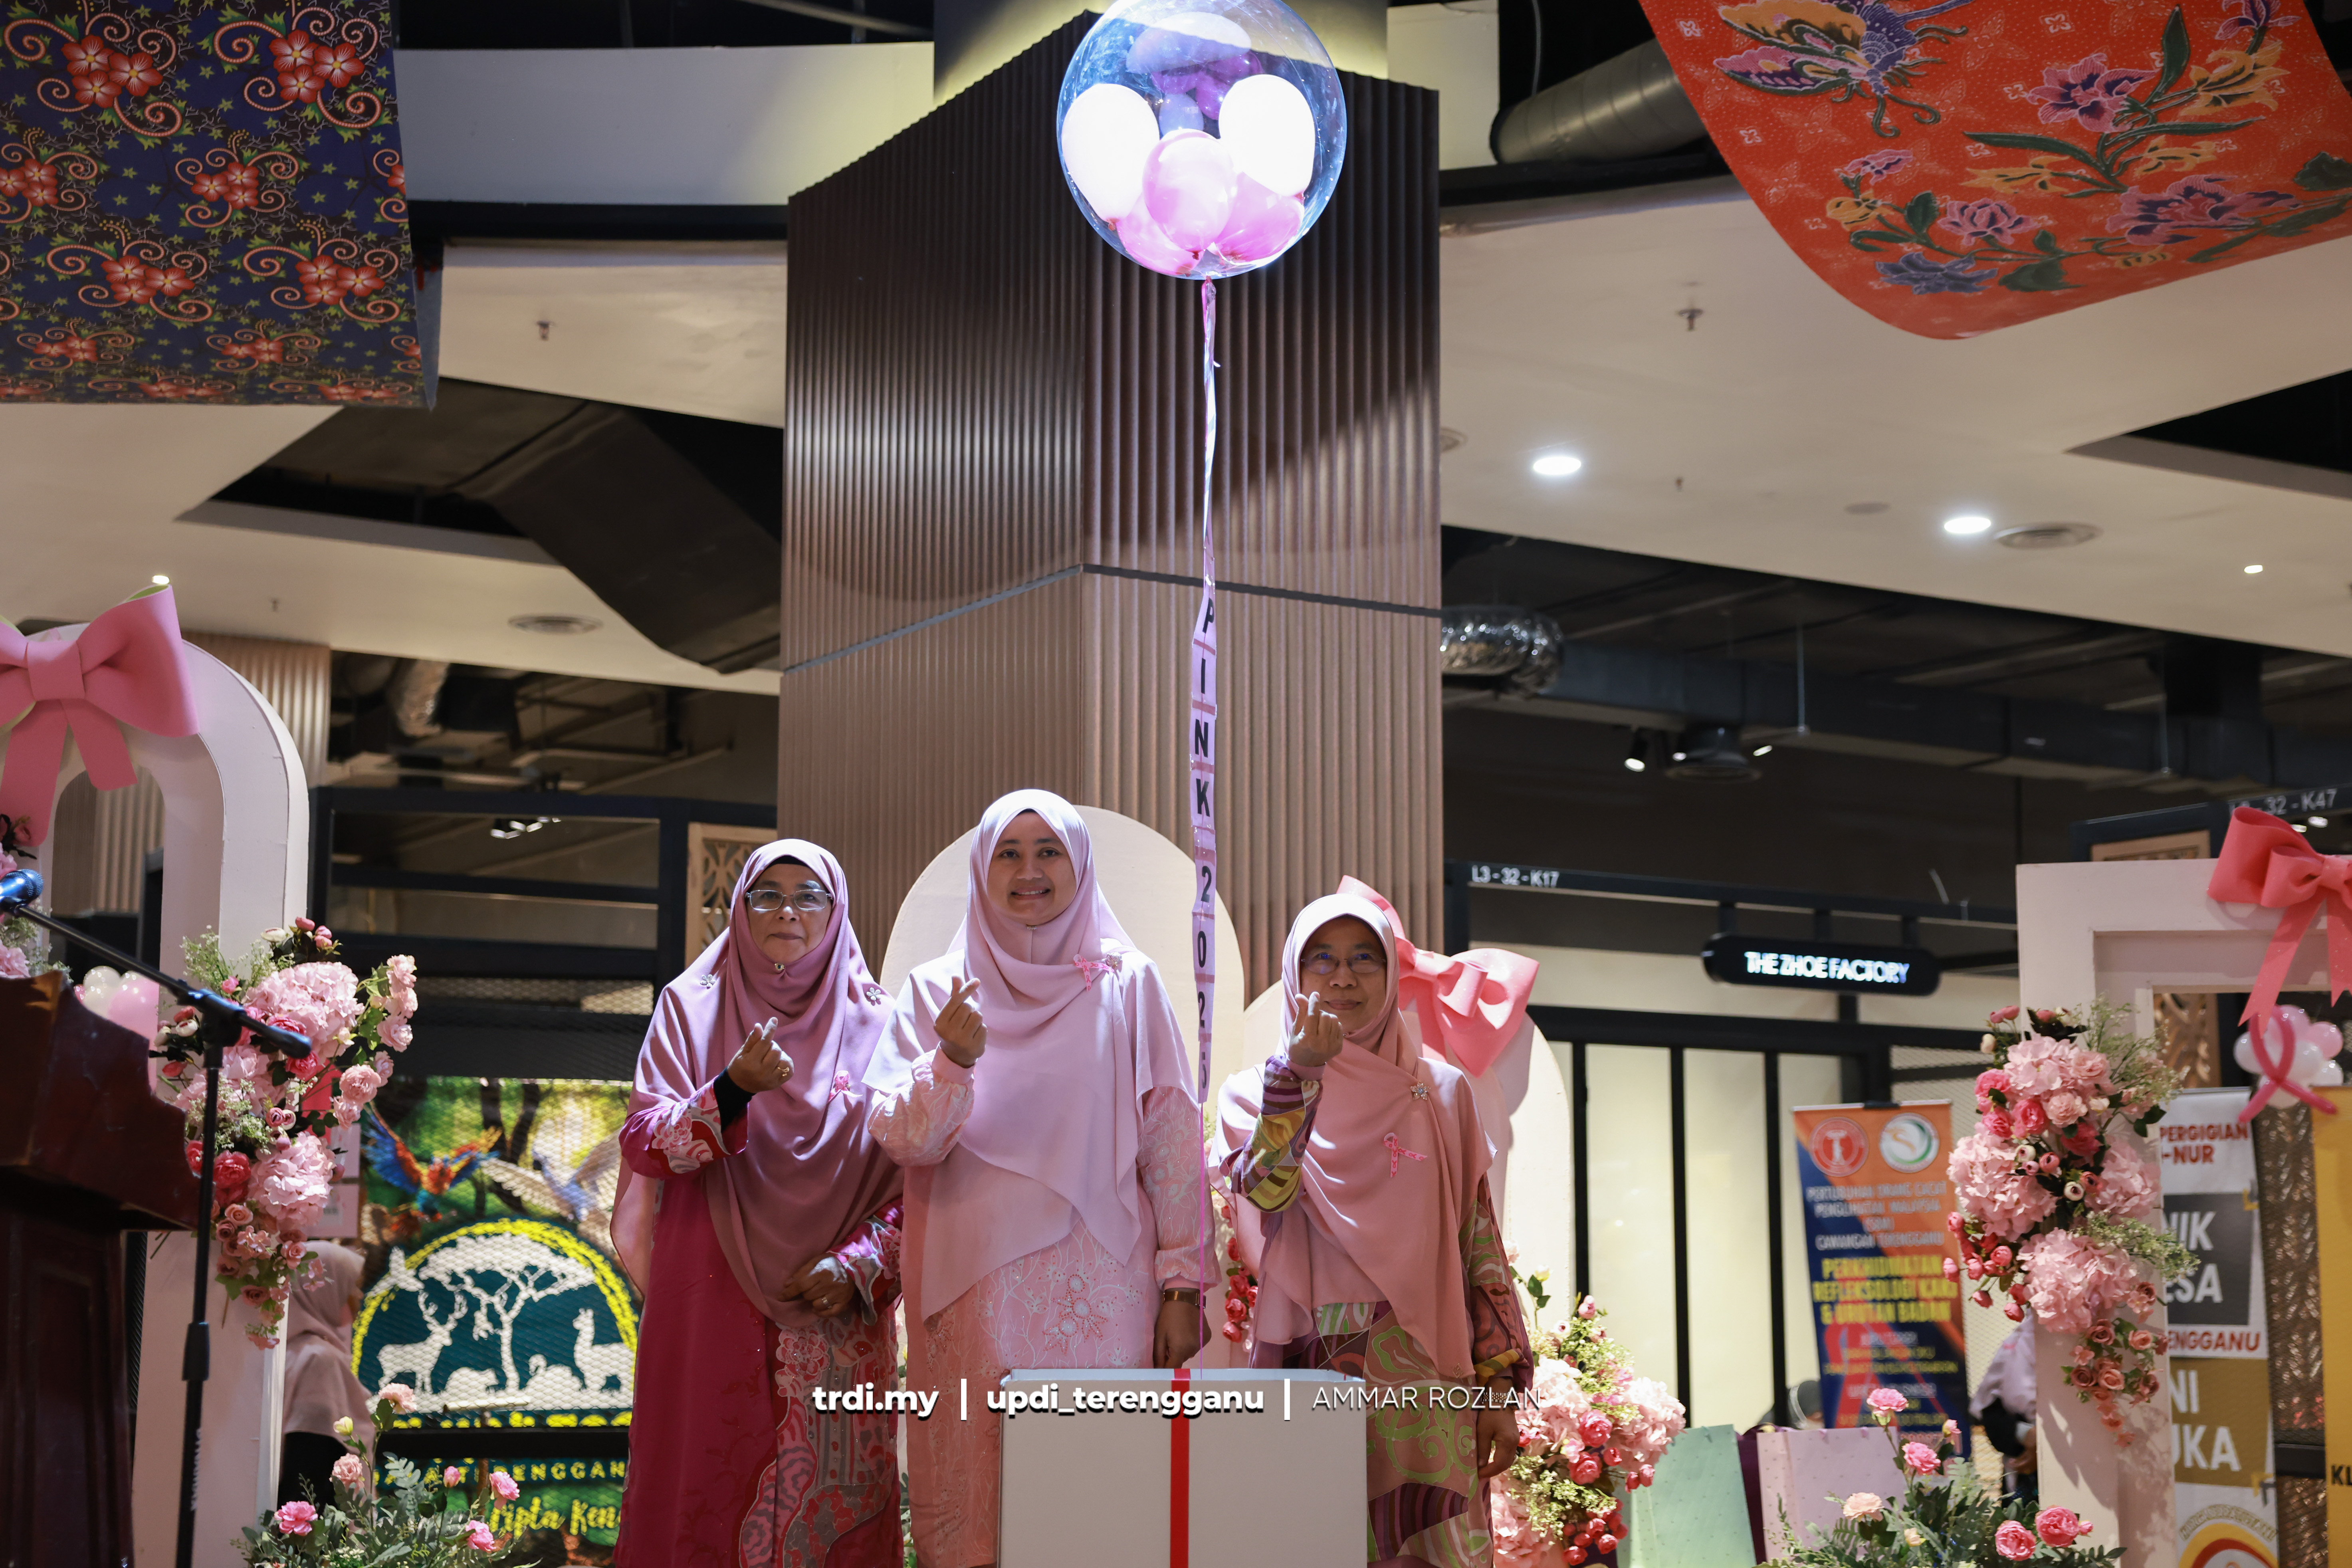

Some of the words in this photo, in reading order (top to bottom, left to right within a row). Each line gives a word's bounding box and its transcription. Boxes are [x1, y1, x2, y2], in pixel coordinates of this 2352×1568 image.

[1195, 597, 1214, 817] PINK
[1197, 865, 1212, 1089] 2025
[1744, 951, 1779, 975] THE
[1779, 954, 1829, 978] ZHOE
[1829, 957, 1910, 983] FACTORY
[2160, 1124, 2248, 1141] PERGIGIAN
[1888, 1199, 1941, 1214] MALAYSIA
[1815, 1233, 1876, 1251] CAWANGAN
[1877, 1231, 1945, 1249] TERENGGANU
[1813, 1279, 1918, 1302] REFLEKSOLOGI
[1897, 1300, 1951, 1322] BADAN
